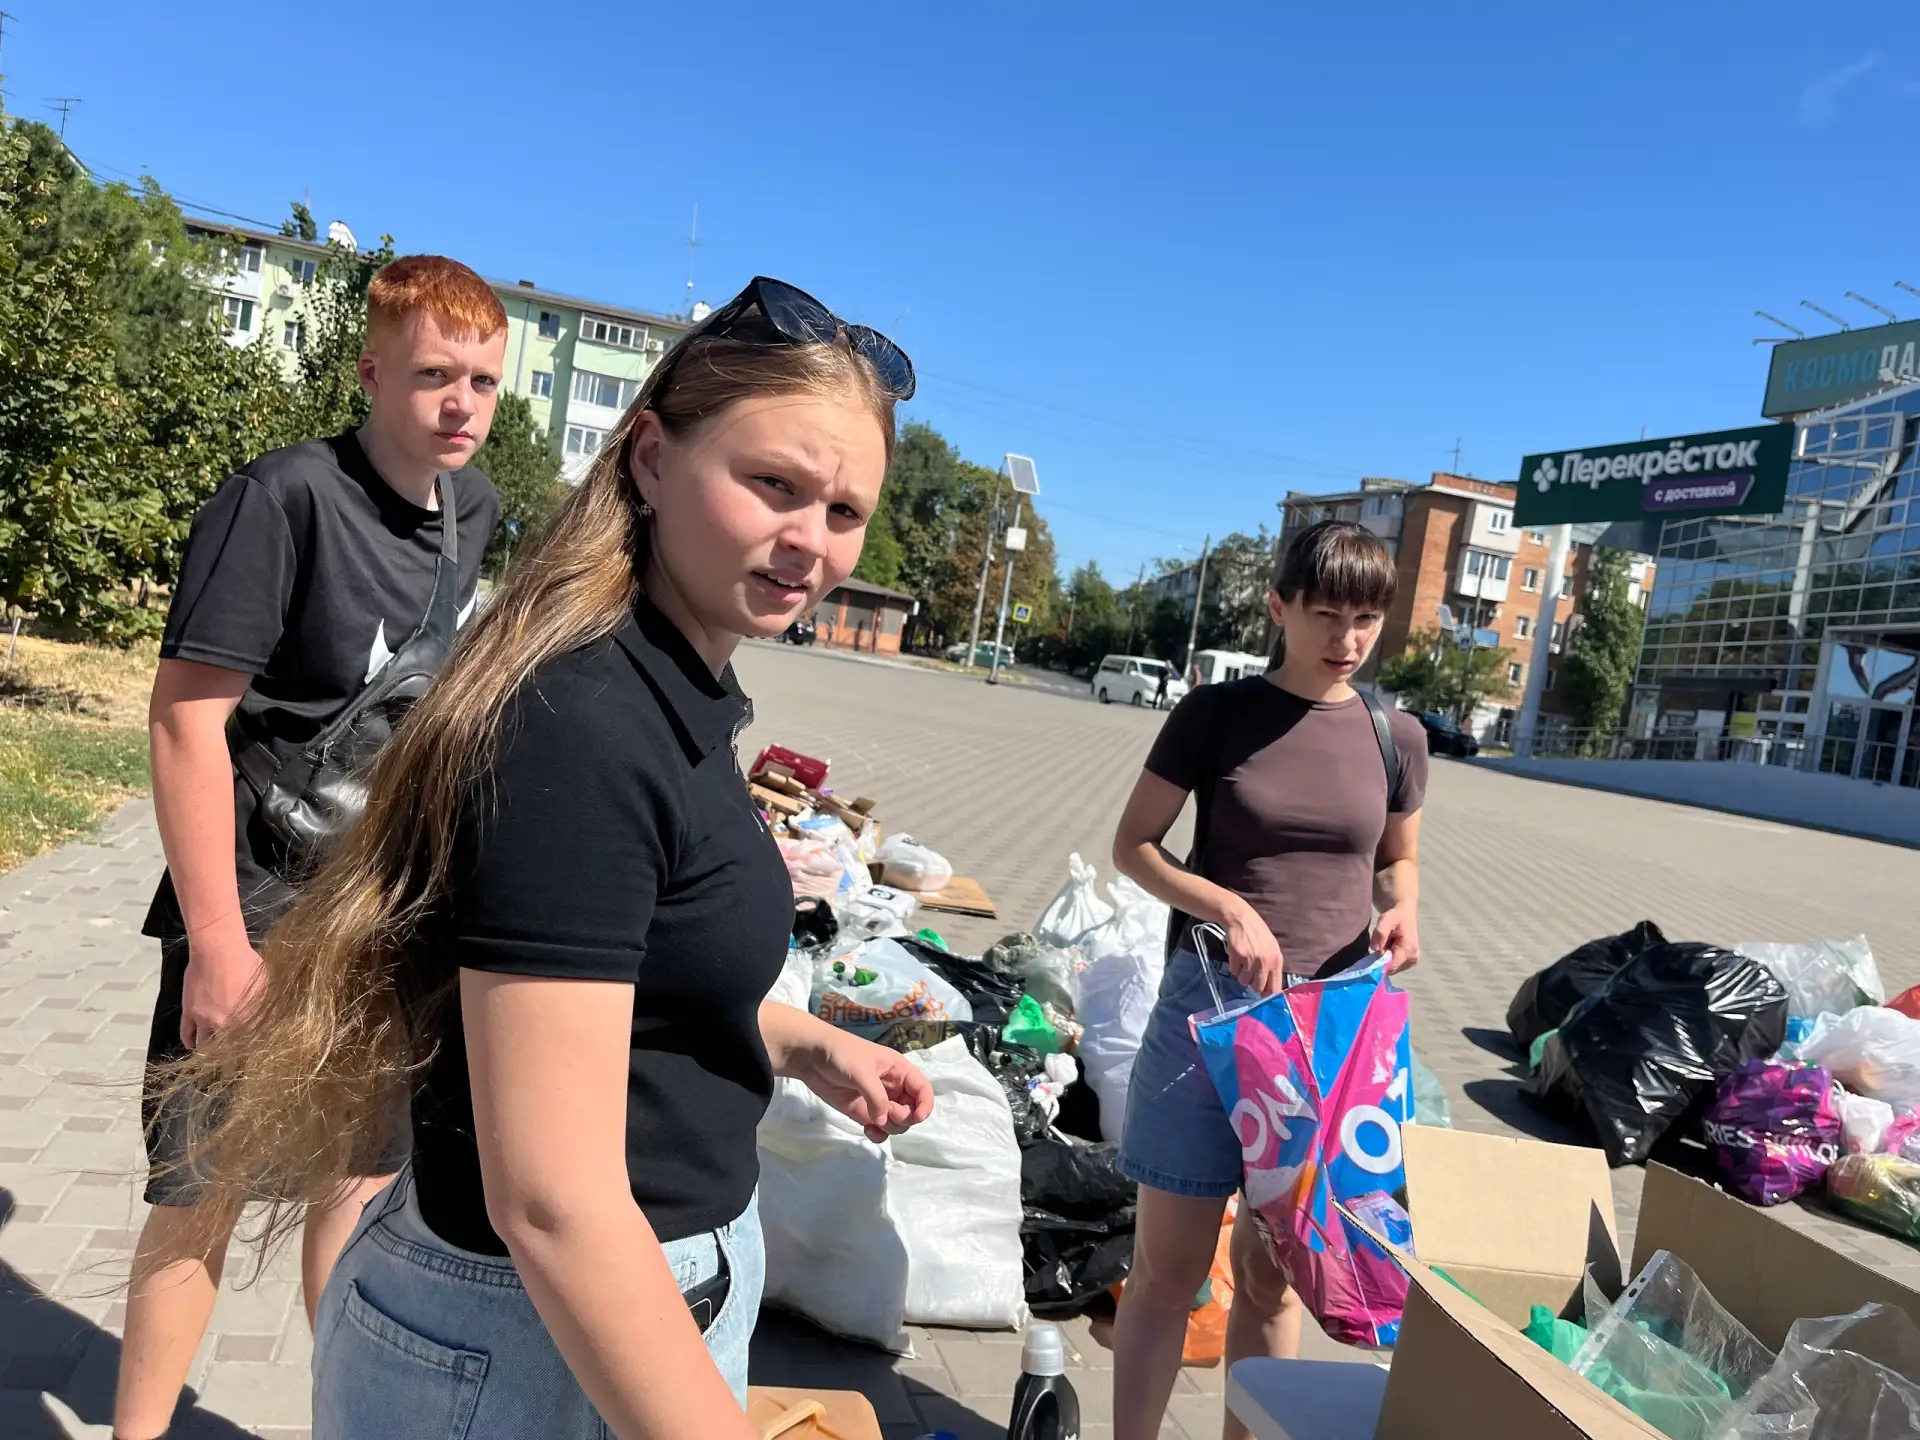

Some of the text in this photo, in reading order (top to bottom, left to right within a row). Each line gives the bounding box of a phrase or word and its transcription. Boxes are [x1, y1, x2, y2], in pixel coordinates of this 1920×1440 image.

[1785, 341, 1920, 392] КОСМОПА
[1559, 440, 1761, 490] Перекрёсток
[1654, 481, 1737, 503] с доставкой
